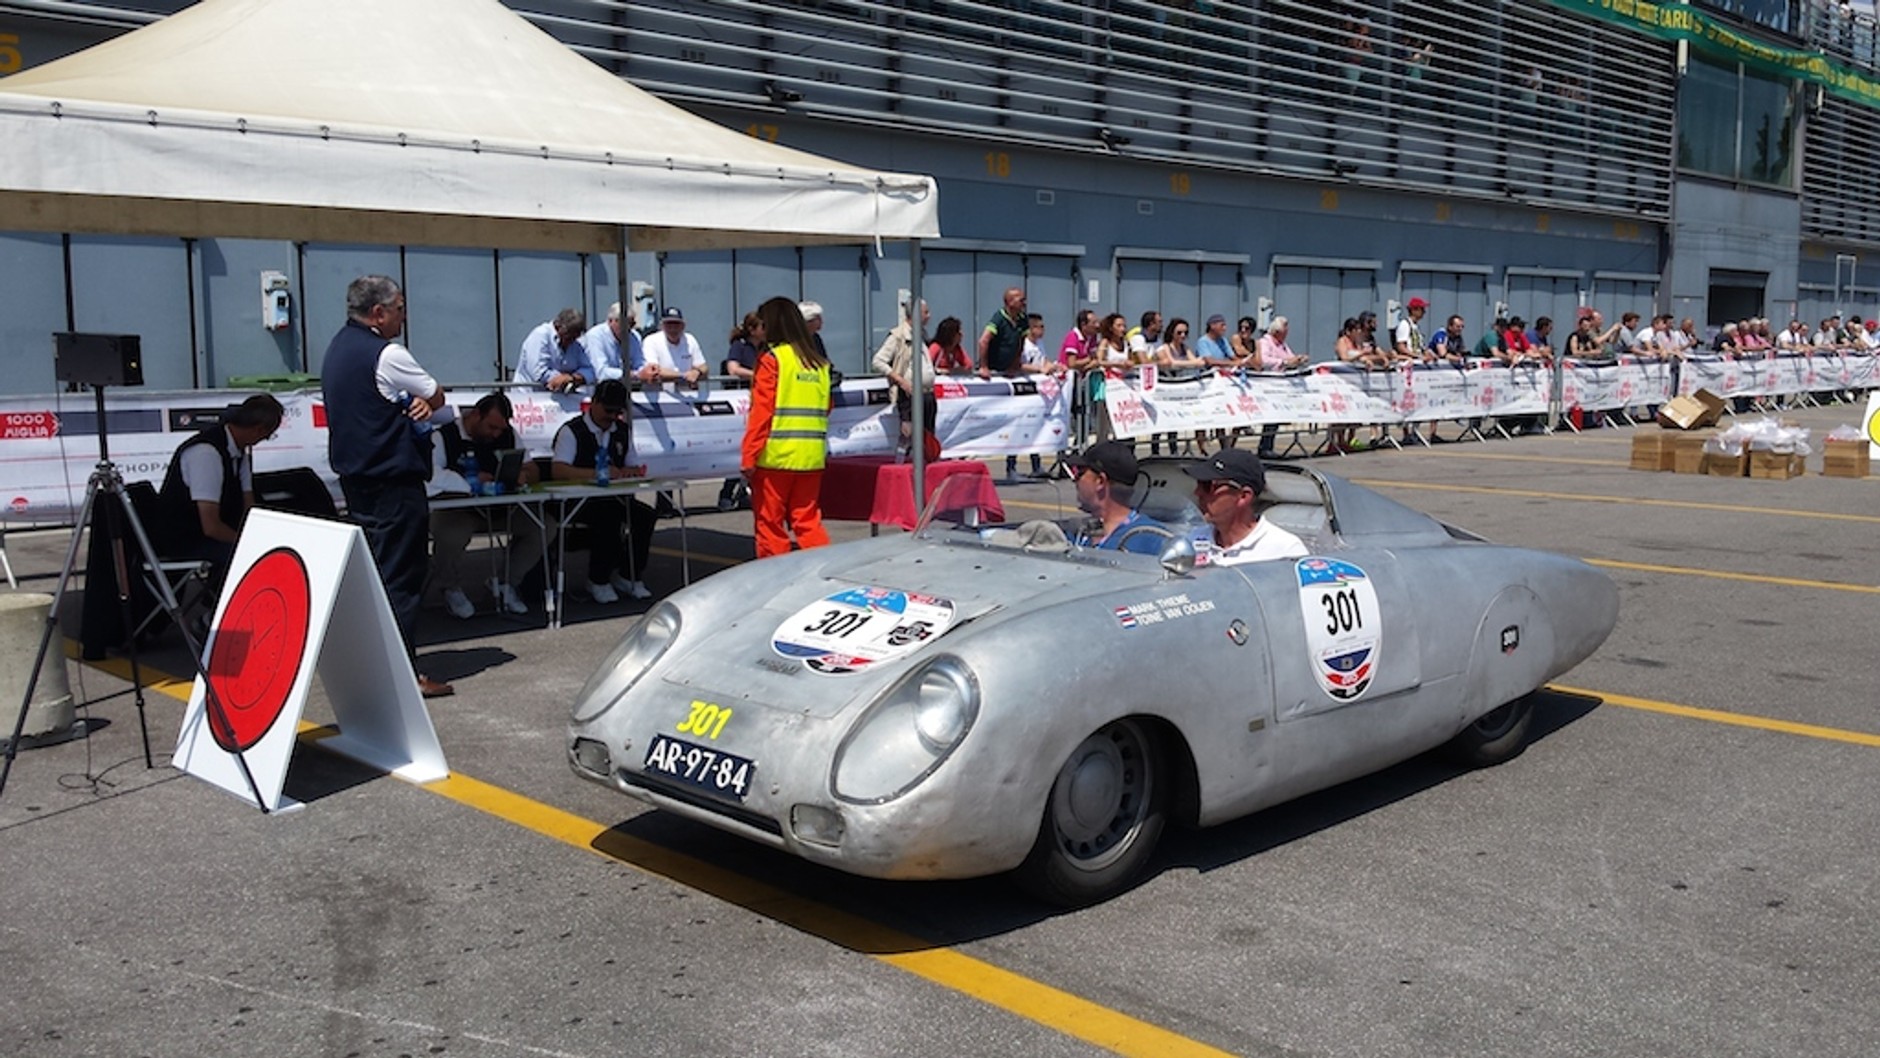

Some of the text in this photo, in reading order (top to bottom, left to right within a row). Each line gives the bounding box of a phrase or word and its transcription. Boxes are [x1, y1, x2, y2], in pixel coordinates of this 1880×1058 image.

[984, 151, 1011, 178] 18
[1169, 172, 1191, 195] 19
[6, 414, 45, 426] 1000
[283, 407, 302, 418] 016
[4, 426, 49, 438] MIGLIA
[1128, 601, 1158, 614] MARK
[1163, 606, 1184, 619] VAN
[1321, 588, 1362, 637] 301
[804, 609, 873, 638] 301
[676, 699, 733, 740] 301
[646, 738, 749, 794] AR-97-84
